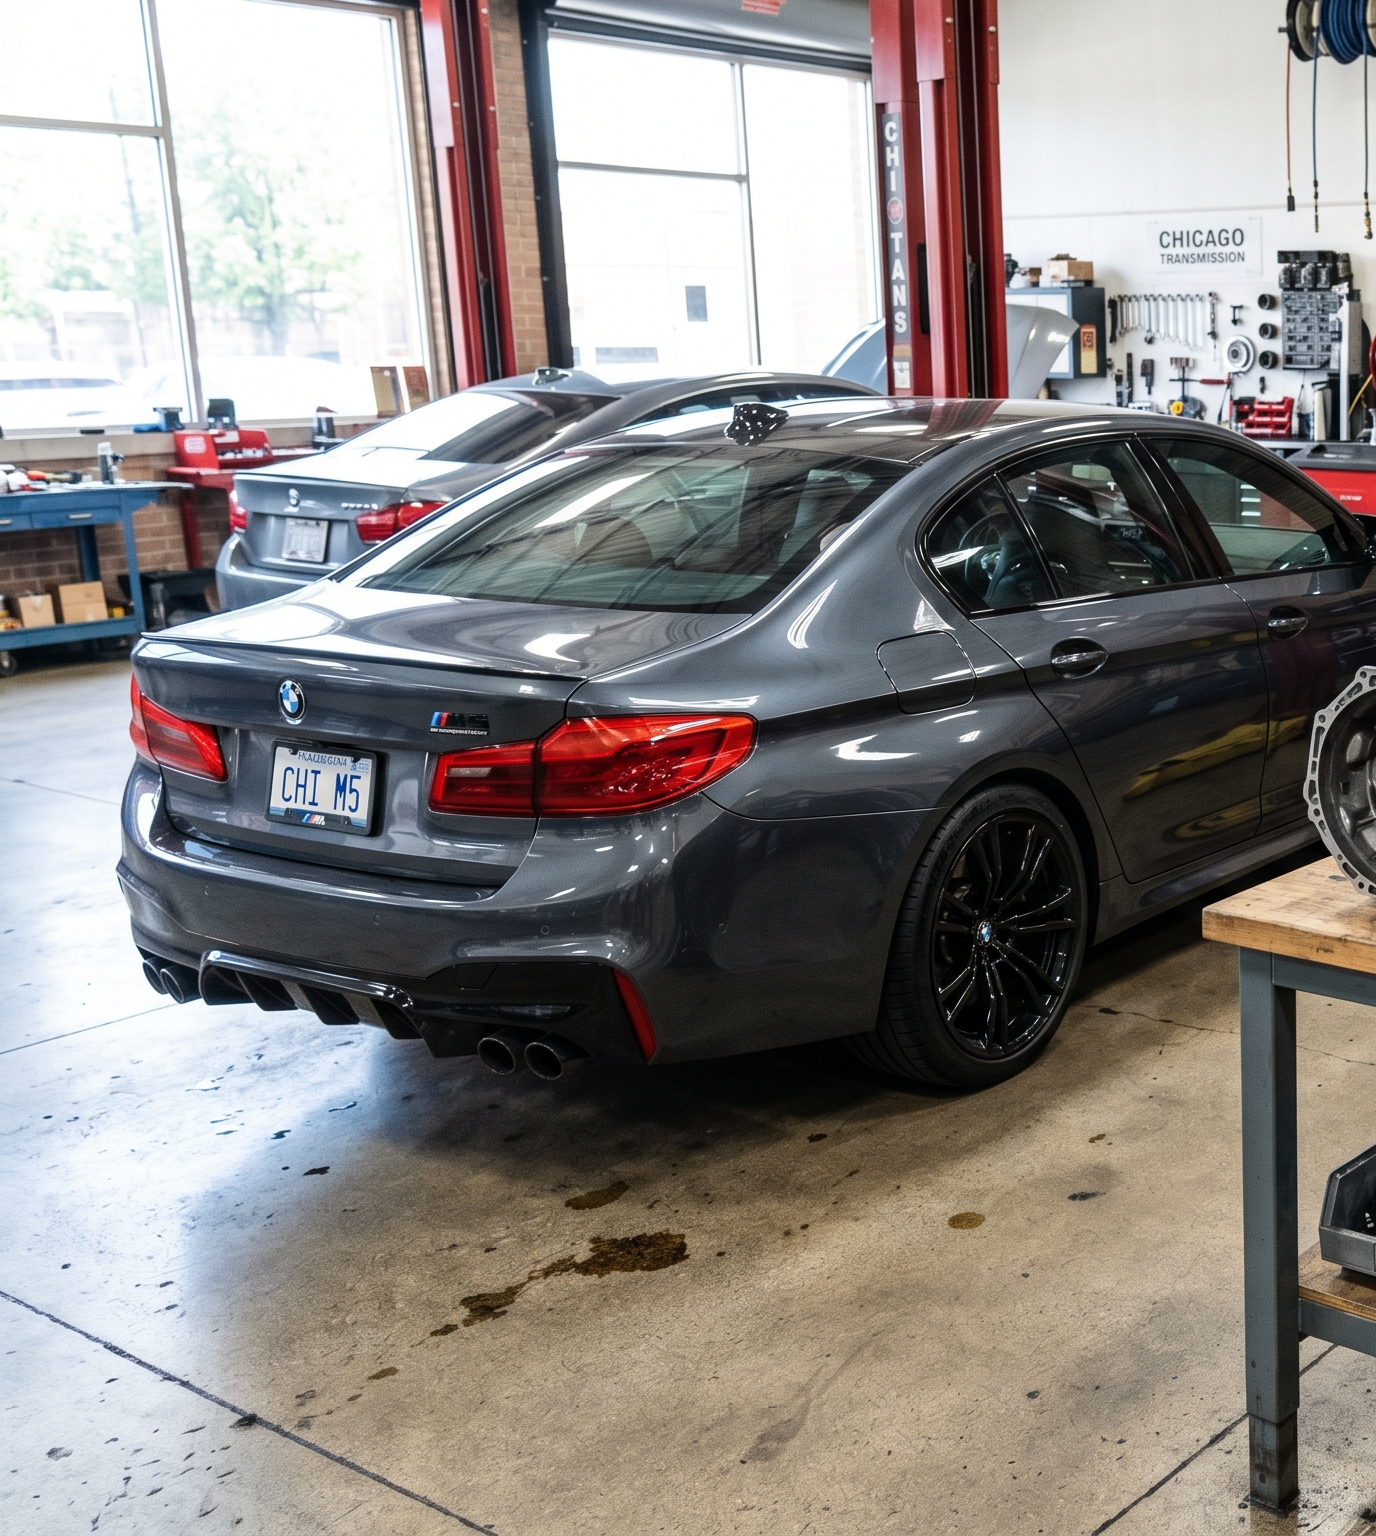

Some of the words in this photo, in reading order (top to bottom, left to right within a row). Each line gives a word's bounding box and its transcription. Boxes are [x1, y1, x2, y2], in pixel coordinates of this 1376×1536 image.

[884, 121, 899, 192] CHI
[1159, 228, 1244, 249] CHICAGO
[1160, 251, 1245, 265] TRANSMISSION
[890, 232, 907, 333] TANS
[281, 766, 321, 807] CHI
[333, 772, 362, 813] M5
